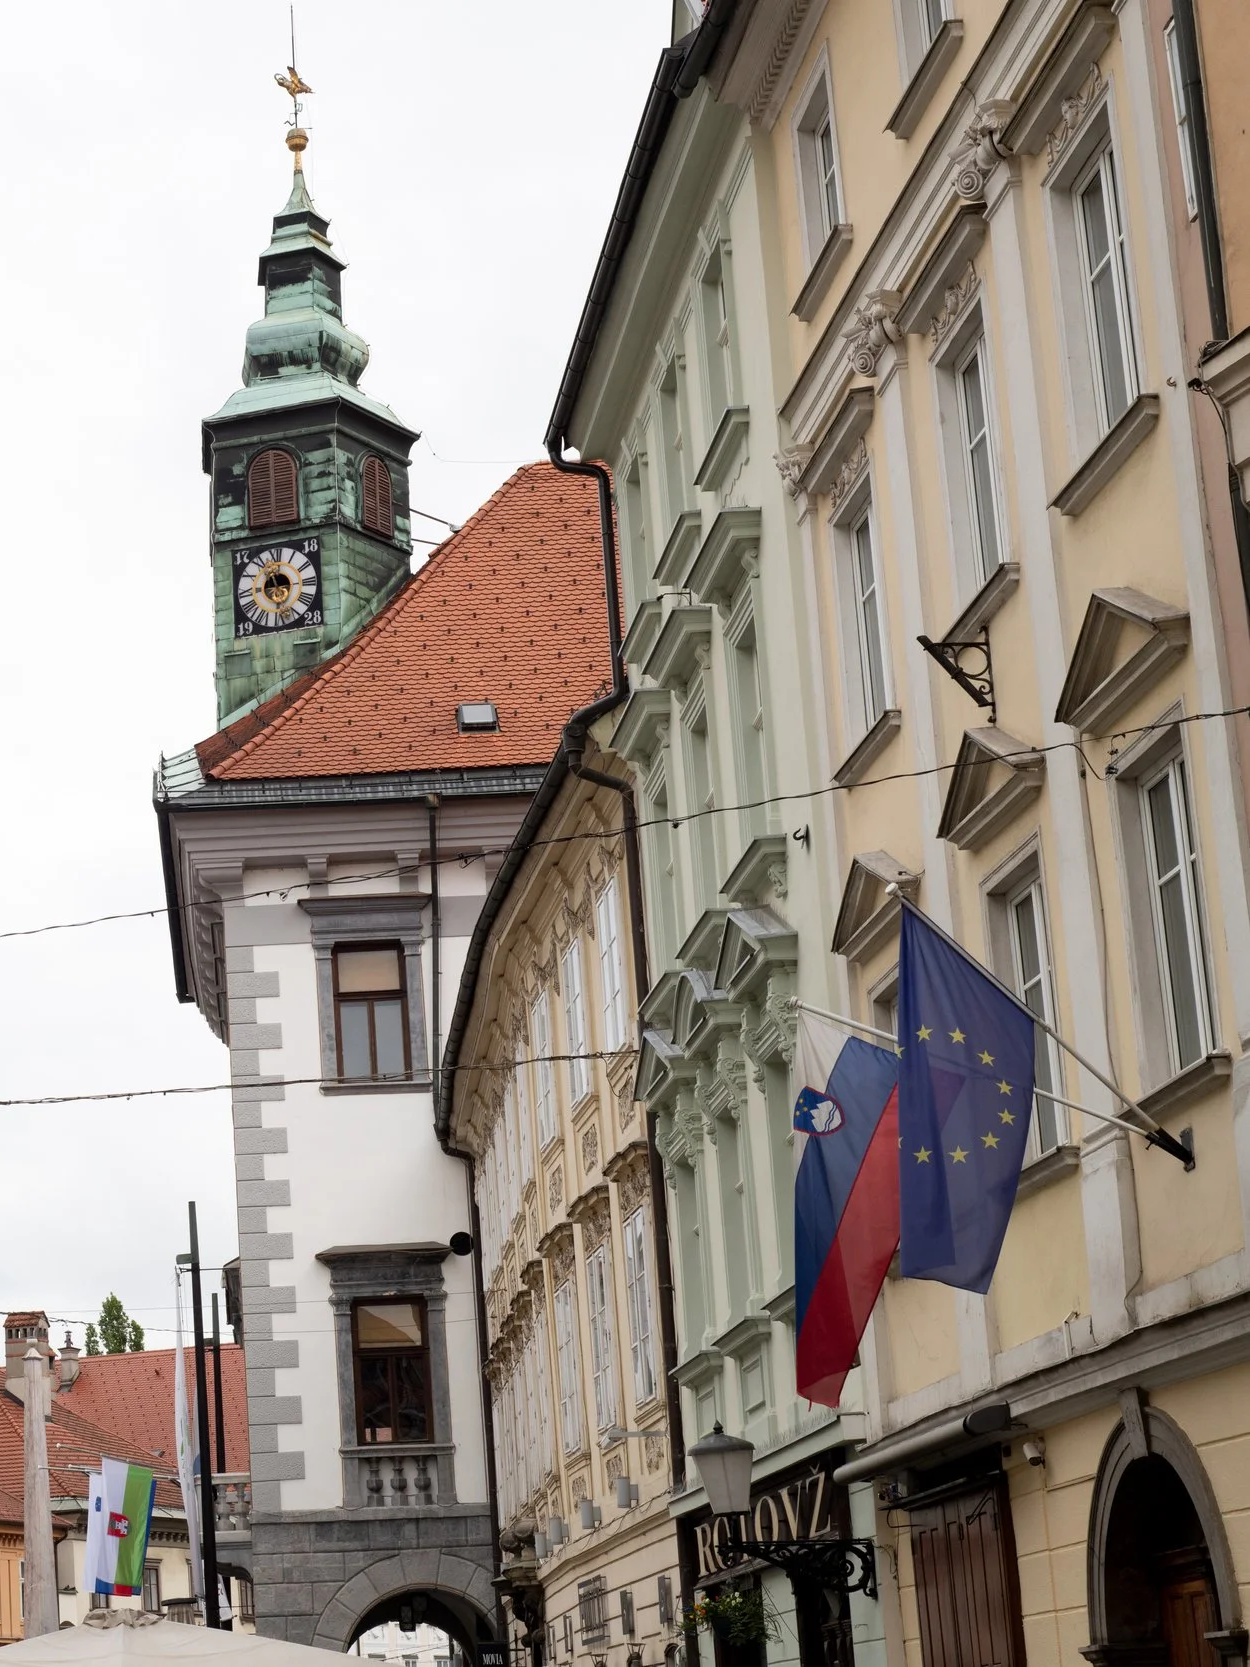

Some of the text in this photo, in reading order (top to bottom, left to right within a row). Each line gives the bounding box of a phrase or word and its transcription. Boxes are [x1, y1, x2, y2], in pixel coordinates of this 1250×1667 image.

[302, 538, 318, 554] 18
[234, 551, 250, 565] 17
[304, 610, 321, 625] 28
[237, 621, 253, 636] 19
[483, 1653, 503, 1665] MOVIA
